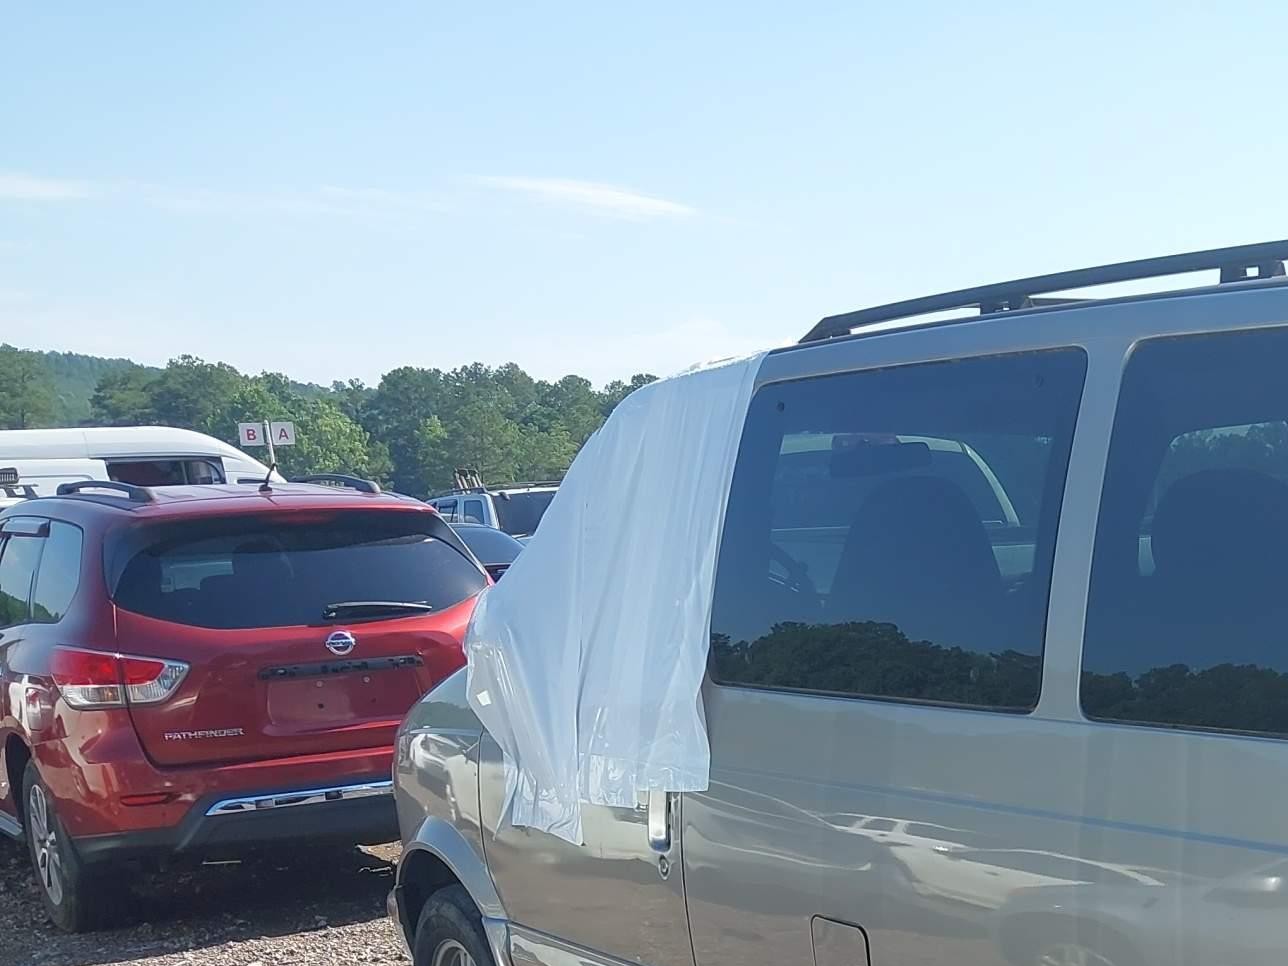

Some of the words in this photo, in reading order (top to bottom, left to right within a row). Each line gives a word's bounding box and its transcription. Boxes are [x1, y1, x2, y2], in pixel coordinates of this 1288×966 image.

[246, 429, 257, 441] B
[279, 428, 289, 441] A
[164, 728, 244, 741] PATHFINDER
